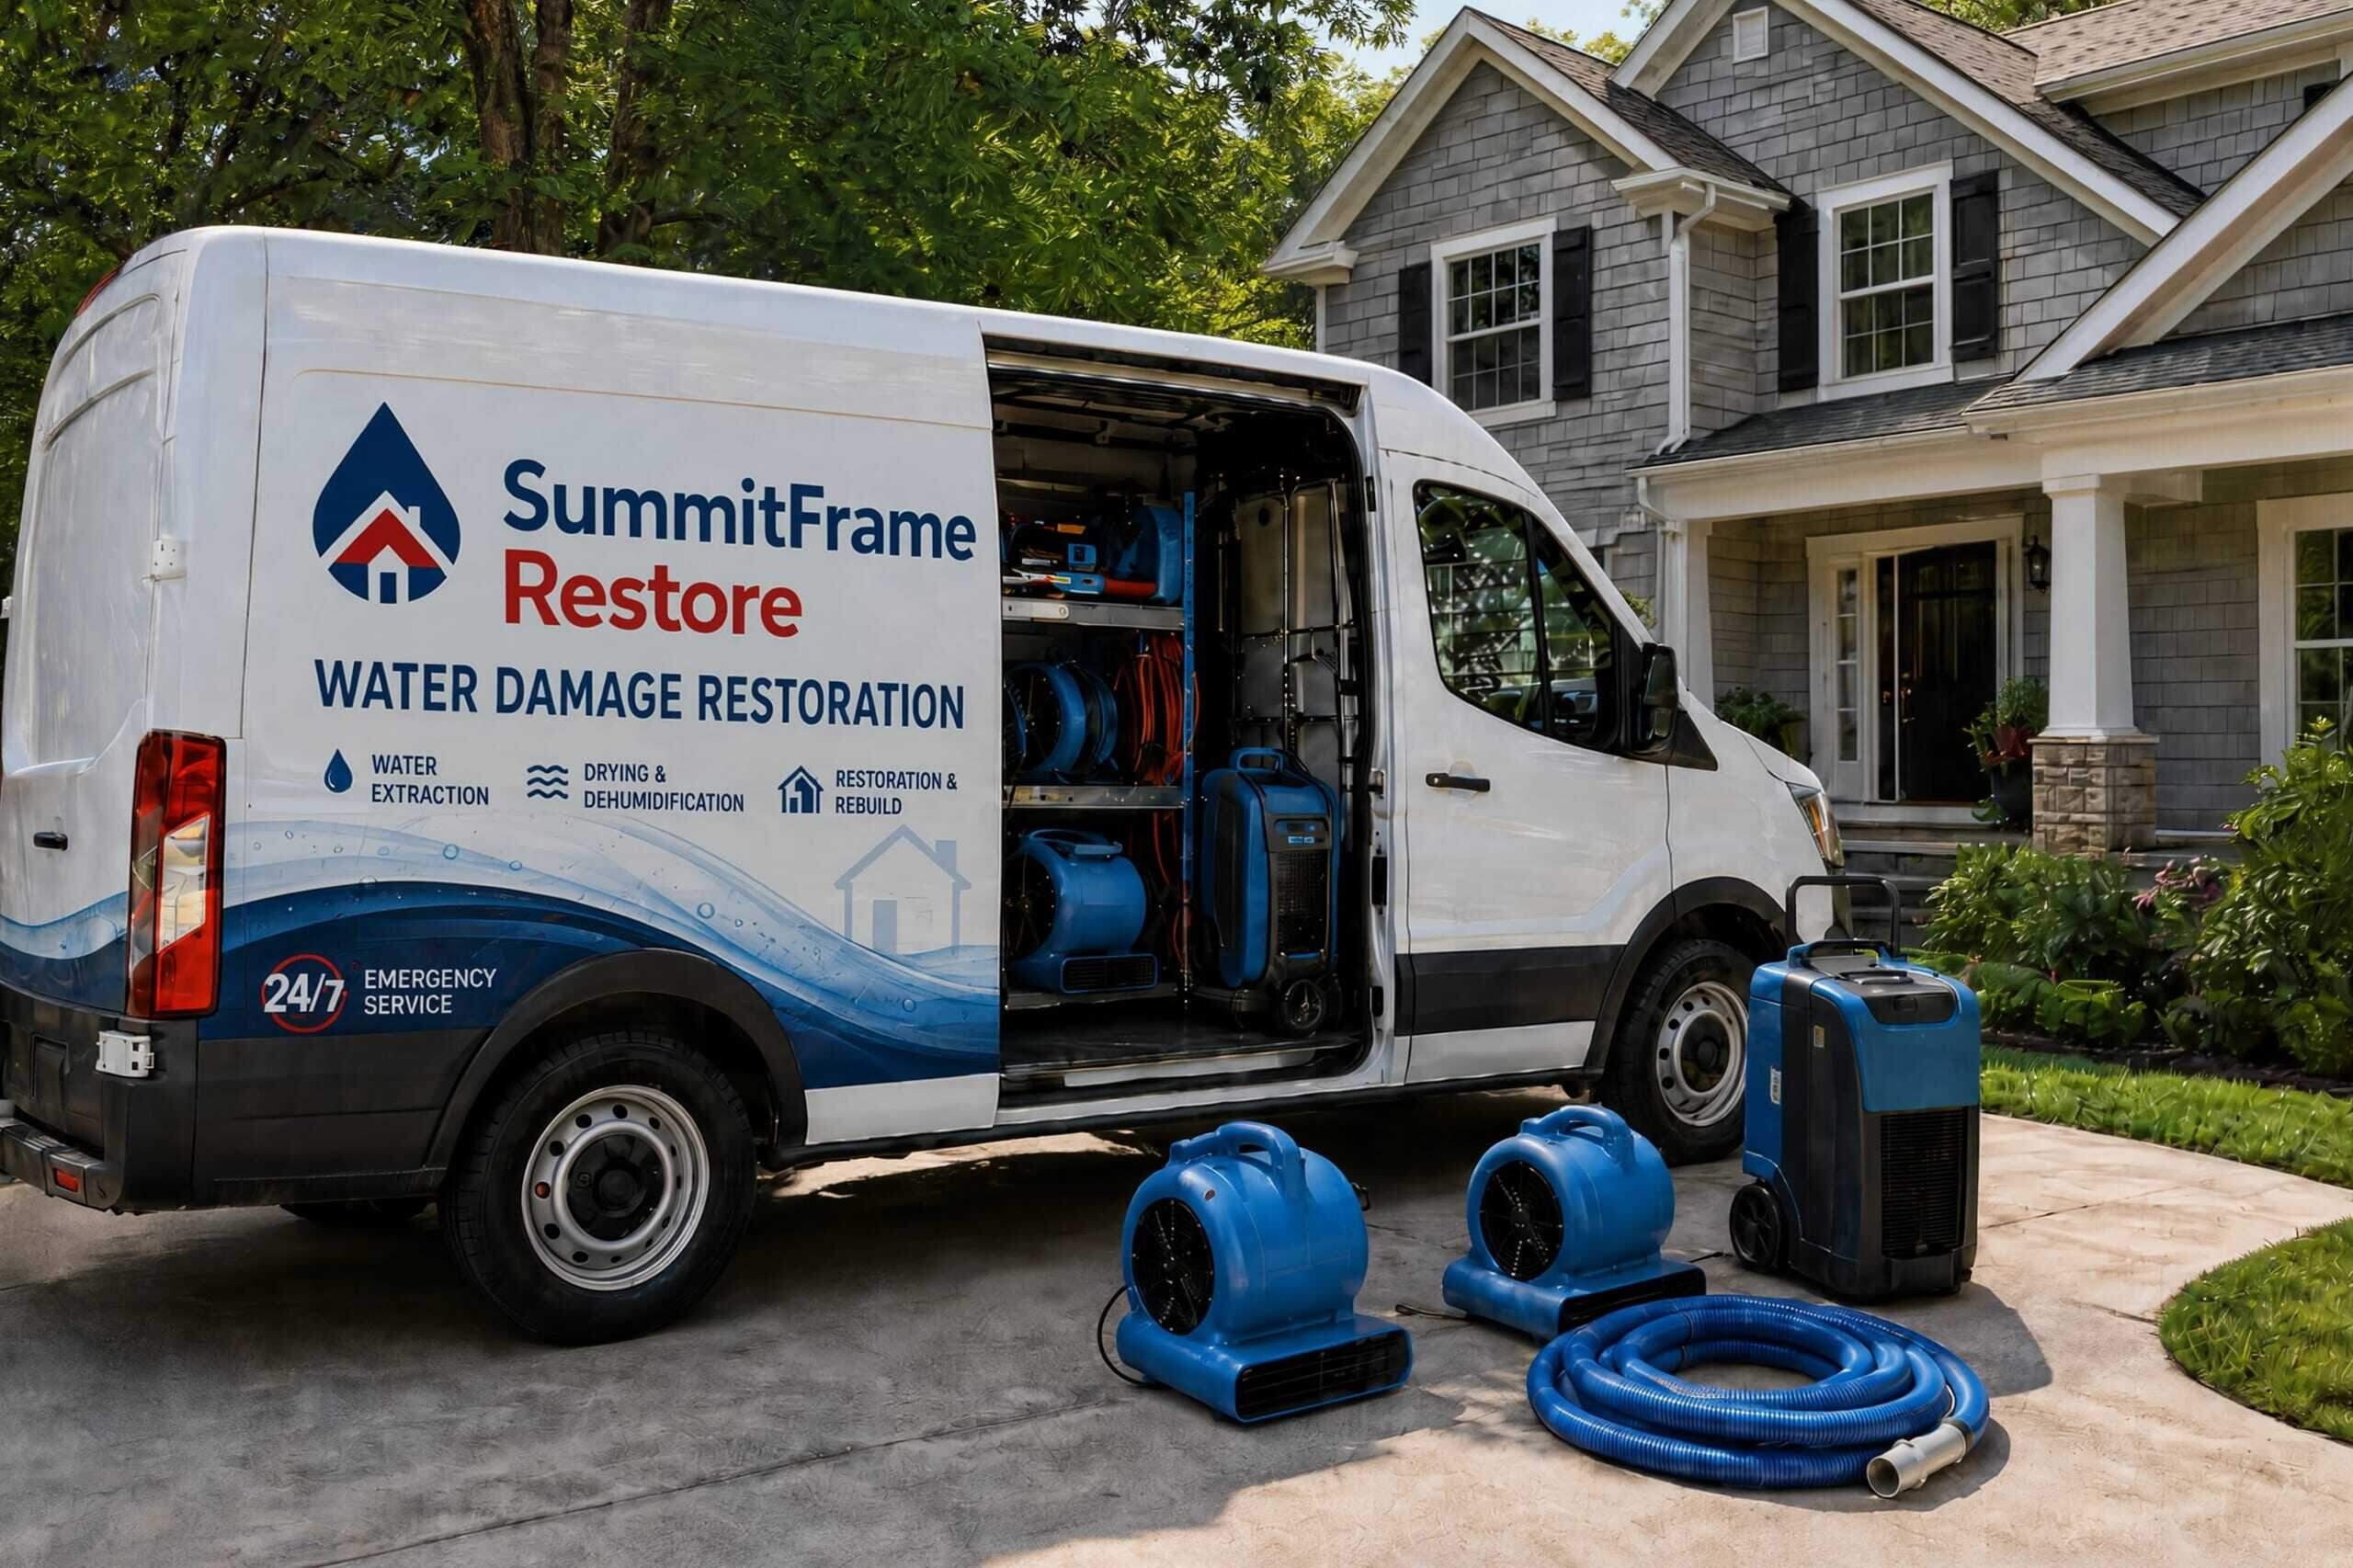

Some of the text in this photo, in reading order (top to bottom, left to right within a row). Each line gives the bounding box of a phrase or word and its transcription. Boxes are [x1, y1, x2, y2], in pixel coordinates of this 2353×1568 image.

[504, 460, 977, 561] SummitFrame
[505, 550, 802, 638] Restore
[313, 658, 964, 730] WATER DAMAGE RESTORATION
[371, 754, 438, 777] WATER
[584, 763, 666, 783] DRYING &
[835, 769, 958, 790] RESTORATION &
[371, 783, 489, 806] EXTRACTION
[584, 790, 745, 812] DEHUMIDIFICATION
[835, 796, 903, 815] REBUILD
[365, 968, 497, 989] EMERGENCY
[264, 972, 345, 1013] 24/7
[364, 994, 452, 1015] SERVICE
